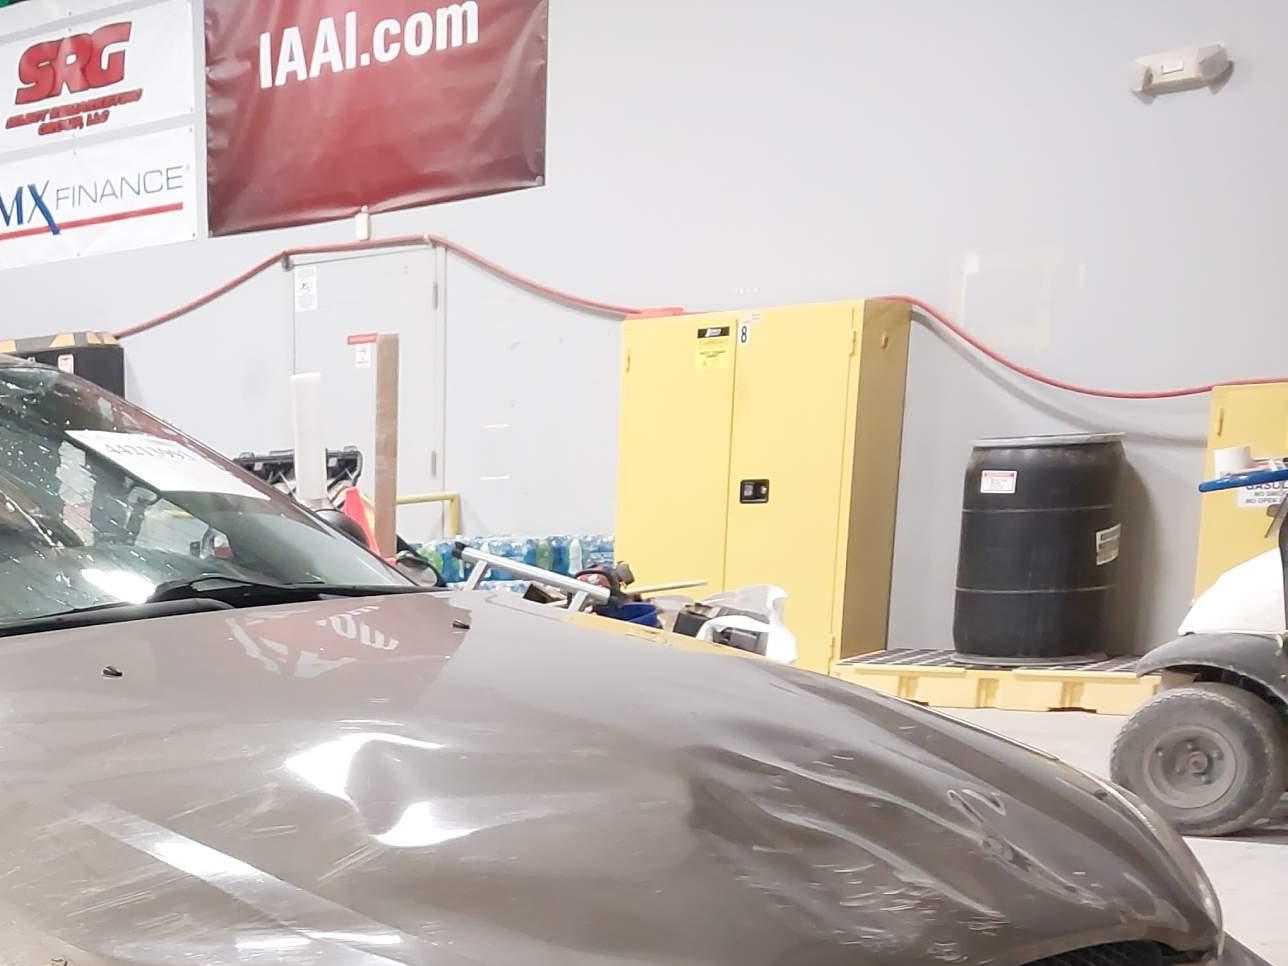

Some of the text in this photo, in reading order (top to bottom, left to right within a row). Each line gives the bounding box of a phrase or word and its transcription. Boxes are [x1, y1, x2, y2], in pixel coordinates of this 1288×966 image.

[14, 20, 133, 105] SRG
[258, 0, 479, 89] IAAI.com
[55, 164, 185, 211] FINANCE
[740, 325, 748, 343] 8
